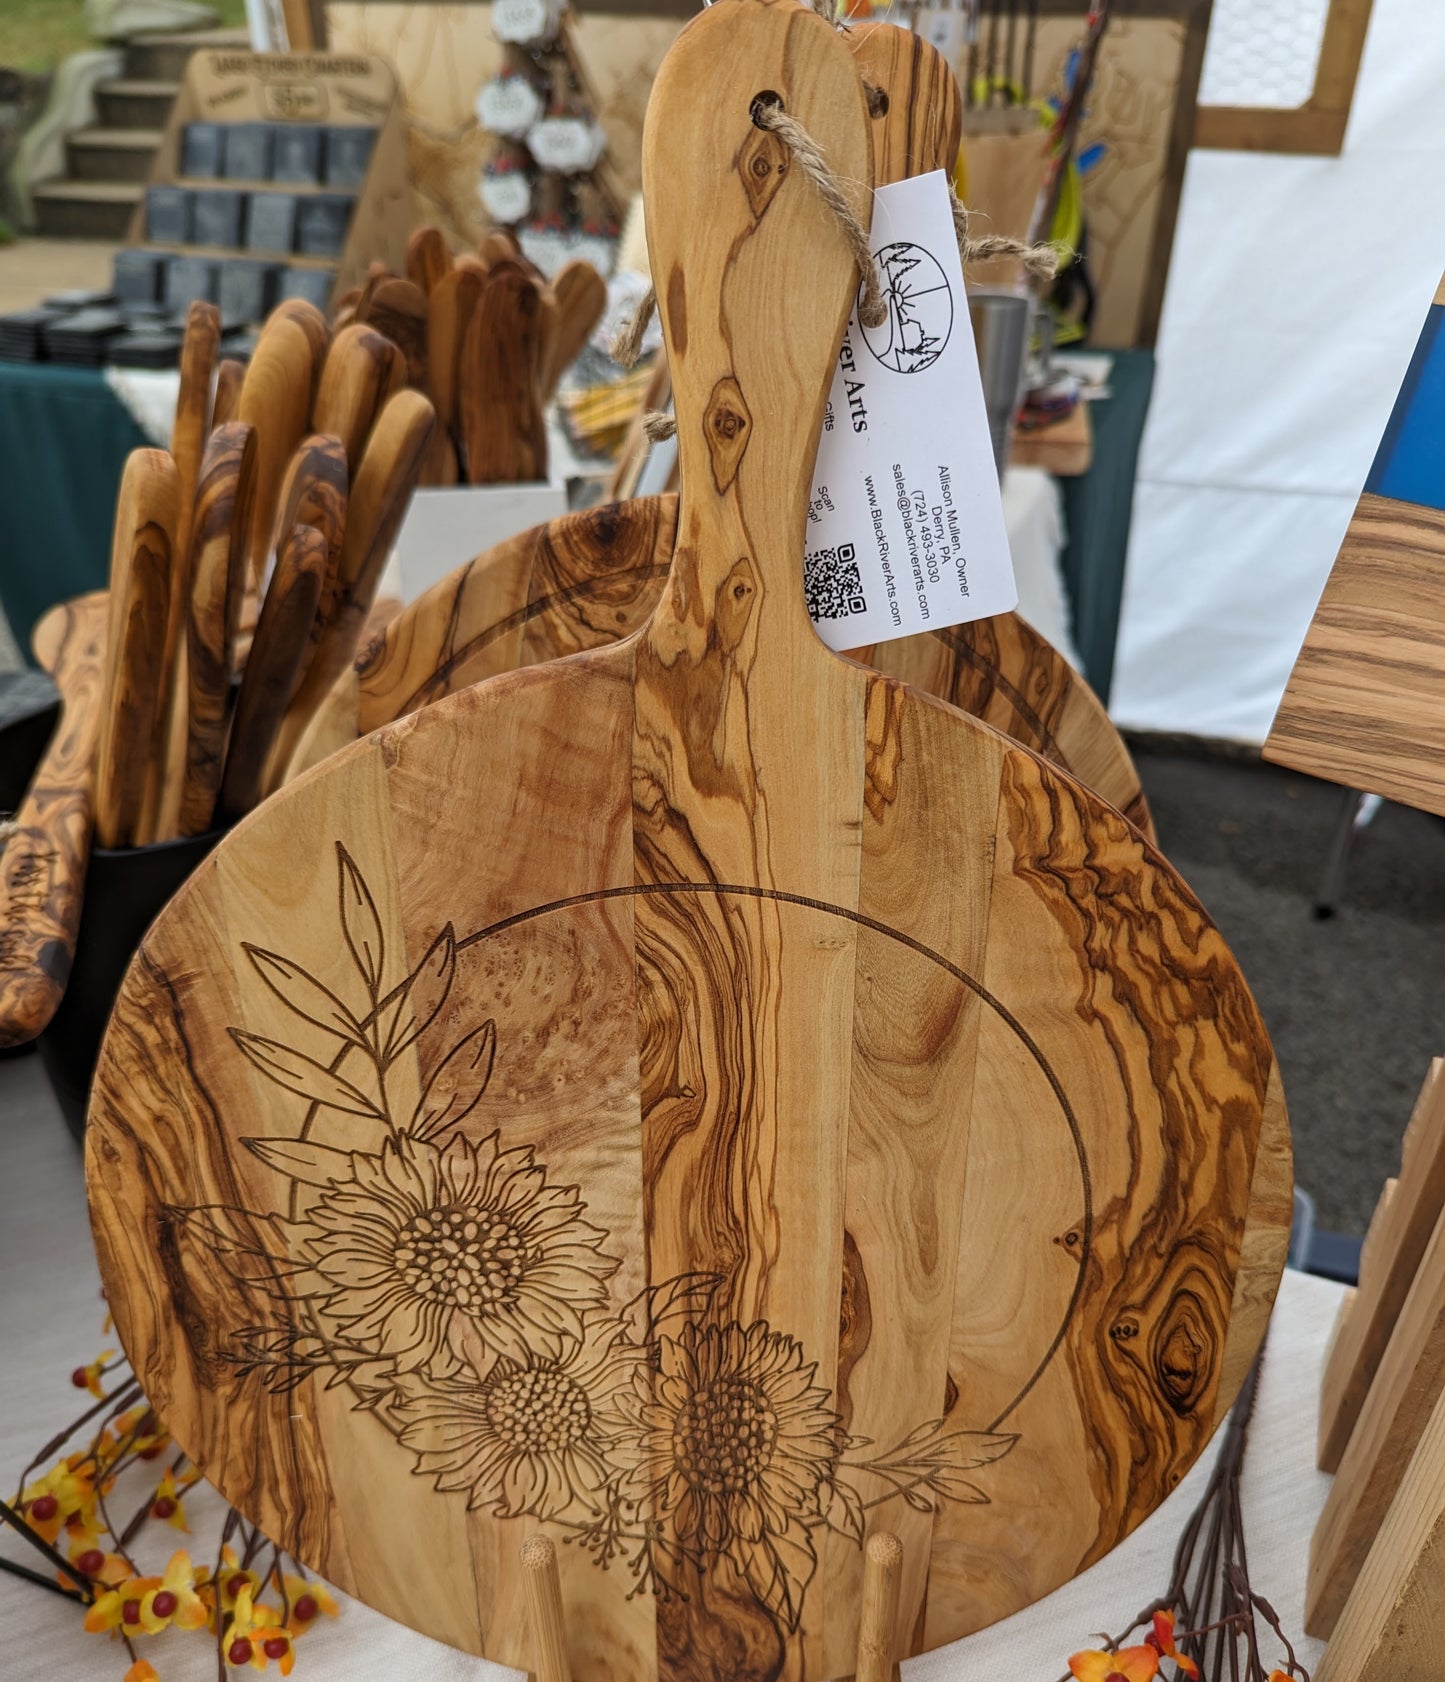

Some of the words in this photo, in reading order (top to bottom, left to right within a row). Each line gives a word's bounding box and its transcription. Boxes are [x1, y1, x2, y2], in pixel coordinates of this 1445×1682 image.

[844, 379, 868, 433] Arts
[813, 499, 823, 510] to
[817, 486, 835, 511] Scan
[911, 490, 928, 523] (724)
[920, 526, 940, 583] 493-3030
[932, 506, 945, 543] Derry,
[939, 546, 951, 565] PA
[938, 465, 953, 507] Allison
[946, 509, 961, 555] Mullen,
[956, 557, 970, 598] Owner
[864, 475, 902, 627] www.BlackRiverArts.com
[892, 463, 930, 620] sales@blackriverarts.com
